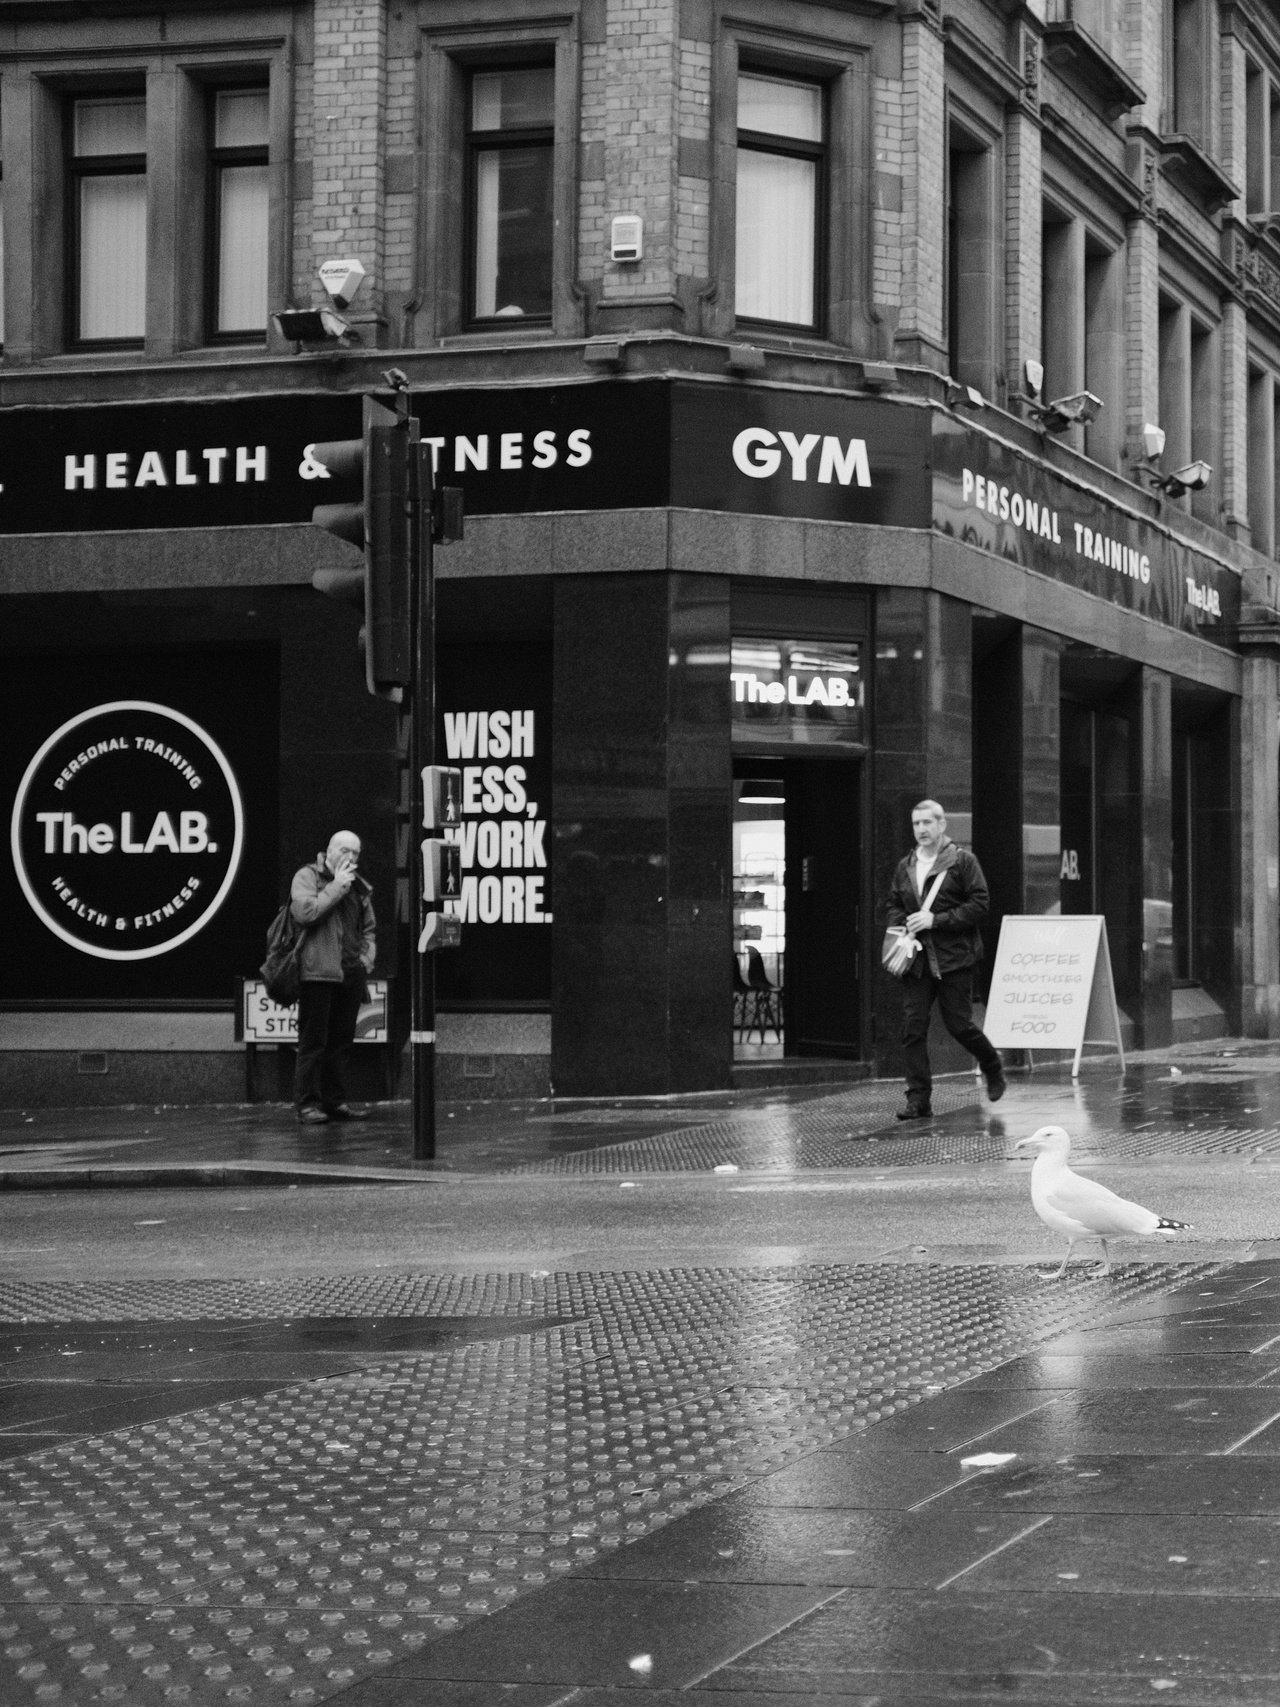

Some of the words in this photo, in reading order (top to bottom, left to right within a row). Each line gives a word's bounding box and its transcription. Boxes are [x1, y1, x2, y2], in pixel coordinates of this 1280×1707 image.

[64, 446, 267, 490] HEALTH
[298, 443, 331, 480] &
[420, 429, 593, 473] TNESS
[732, 427, 872, 487] GYM
[962, 468, 1062, 544] PERSONAL
[1073, 522, 1151, 584] TRAINING
[730, 673, 786, 704] The
[788, 675, 856, 707] LAB.
[444, 710, 535, 759] WISH
[53, 737, 129, 790] PERSONAL
[135, 737, 202, 789] TRAINING
[460, 765, 538, 818] ESS,
[36, 812, 114, 854] The
[121, 811, 218, 854] LAB.
[1060, 849, 1081, 880] AB.
[52, 876, 108, 927] HEALTH
[115, 917, 126, 930] &
[134, 876, 200, 929] FITNESS
[1002, 974, 1082, 983] SMOOTHIES
[1010, 953, 1081, 965] COFFEE
[1003, 992, 1074, 1004] JUICES
[265, 1018, 299, 1033] STR
[1010, 1021, 1057, 1033] FOOD
